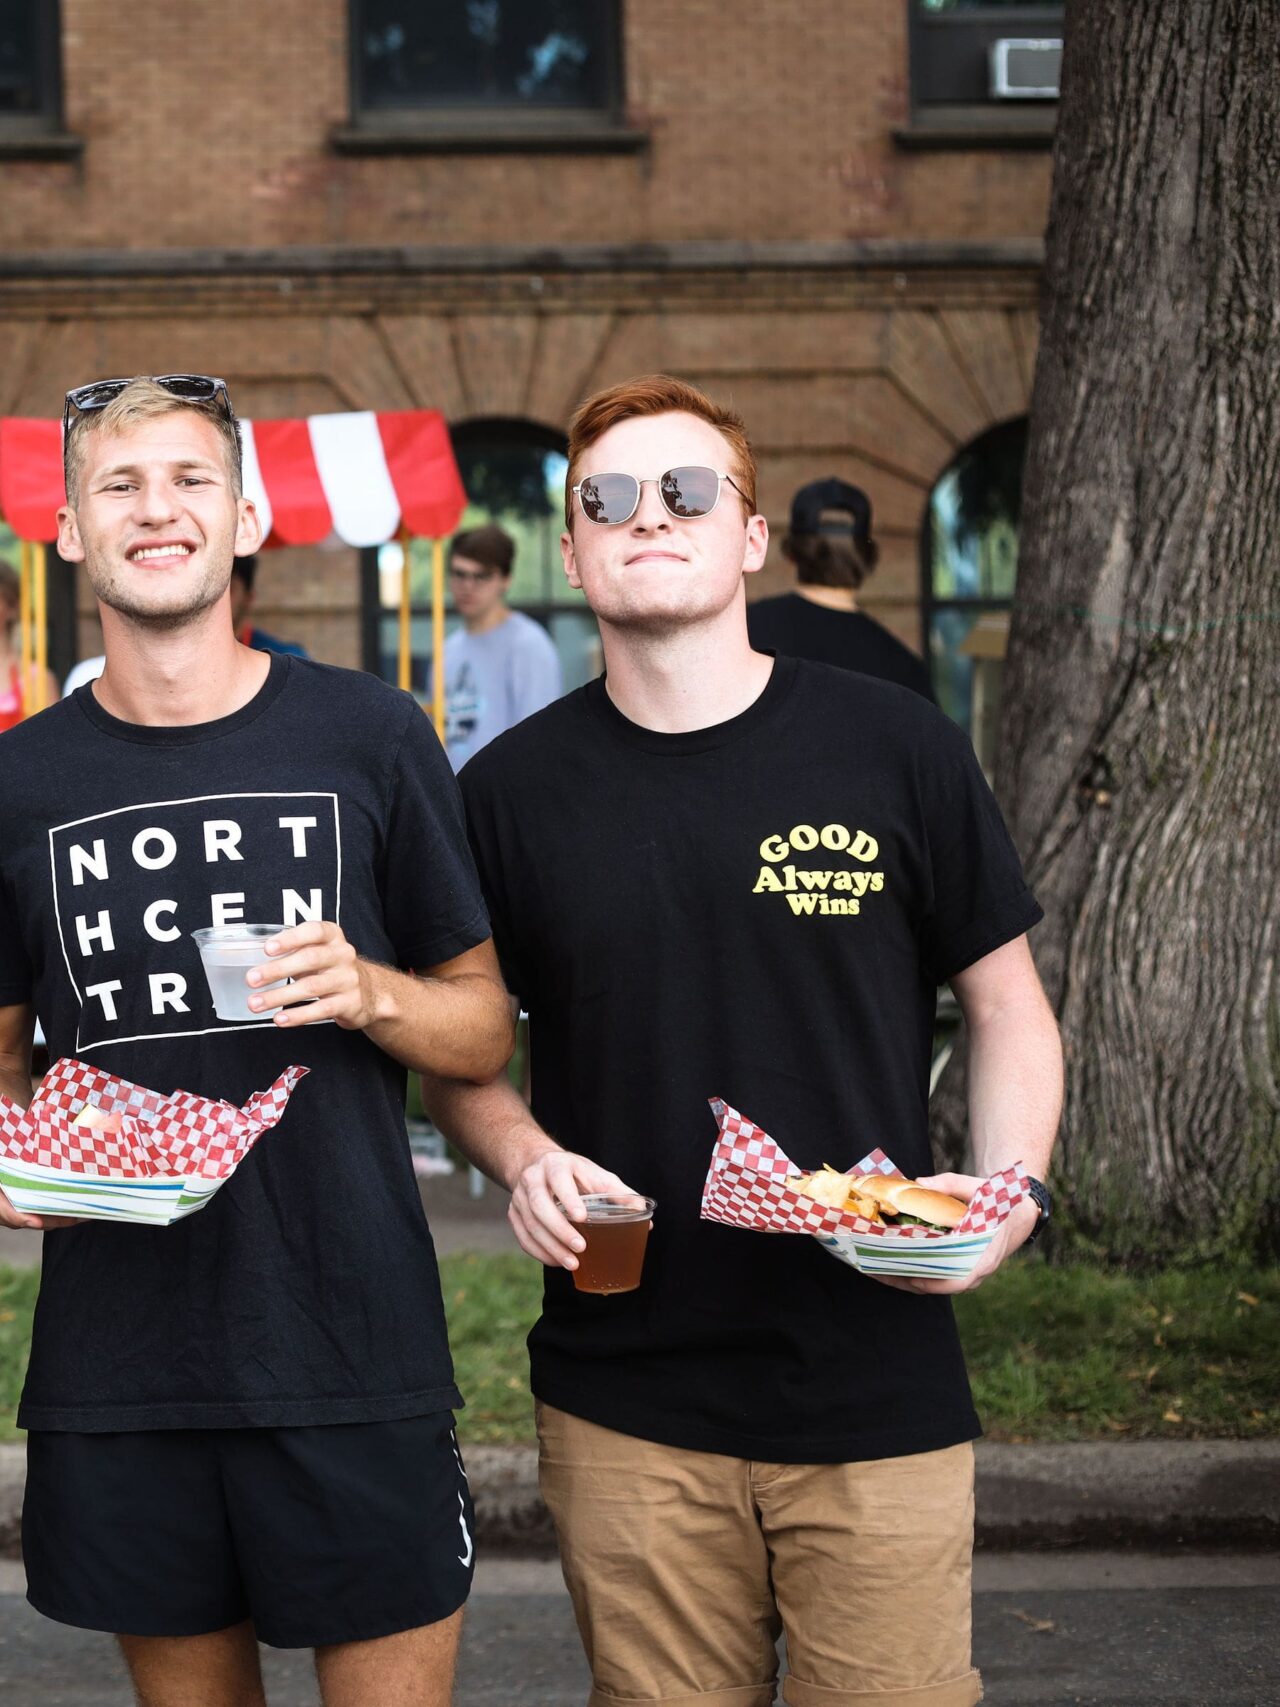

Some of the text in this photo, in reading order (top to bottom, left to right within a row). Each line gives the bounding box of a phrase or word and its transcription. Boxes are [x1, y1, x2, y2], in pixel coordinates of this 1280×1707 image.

[69, 816, 318, 886] NORT
[759, 823, 879, 863] GOOD
[752, 864, 885, 897] Always
[75, 888, 322, 957] HCEN
[785, 892, 860, 916] Wins
